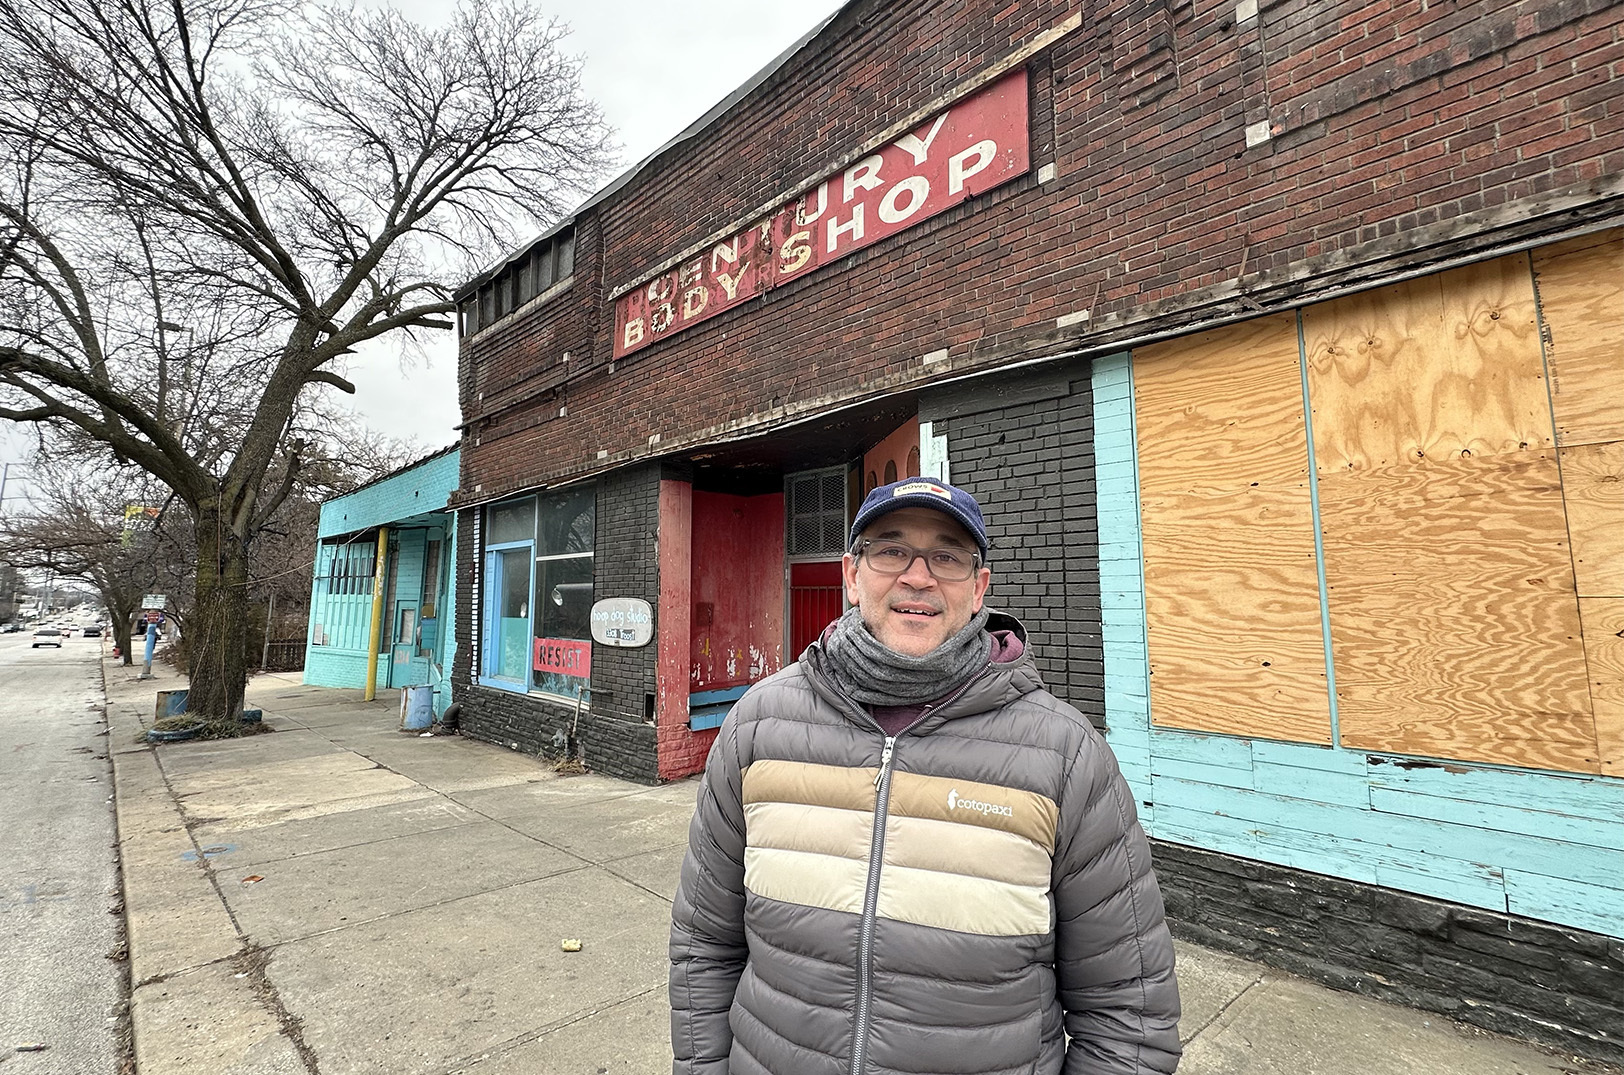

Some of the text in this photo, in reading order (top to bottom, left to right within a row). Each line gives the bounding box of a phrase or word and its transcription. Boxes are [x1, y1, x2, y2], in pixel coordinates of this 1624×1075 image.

[647, 111, 950, 302] CENTURY
[624, 139, 997, 349] BODY SHOP
[593, 604, 649, 626] hoop dog studio
[539, 645, 582, 670] RESIST
[956, 798, 1013, 817] cotopaxi
